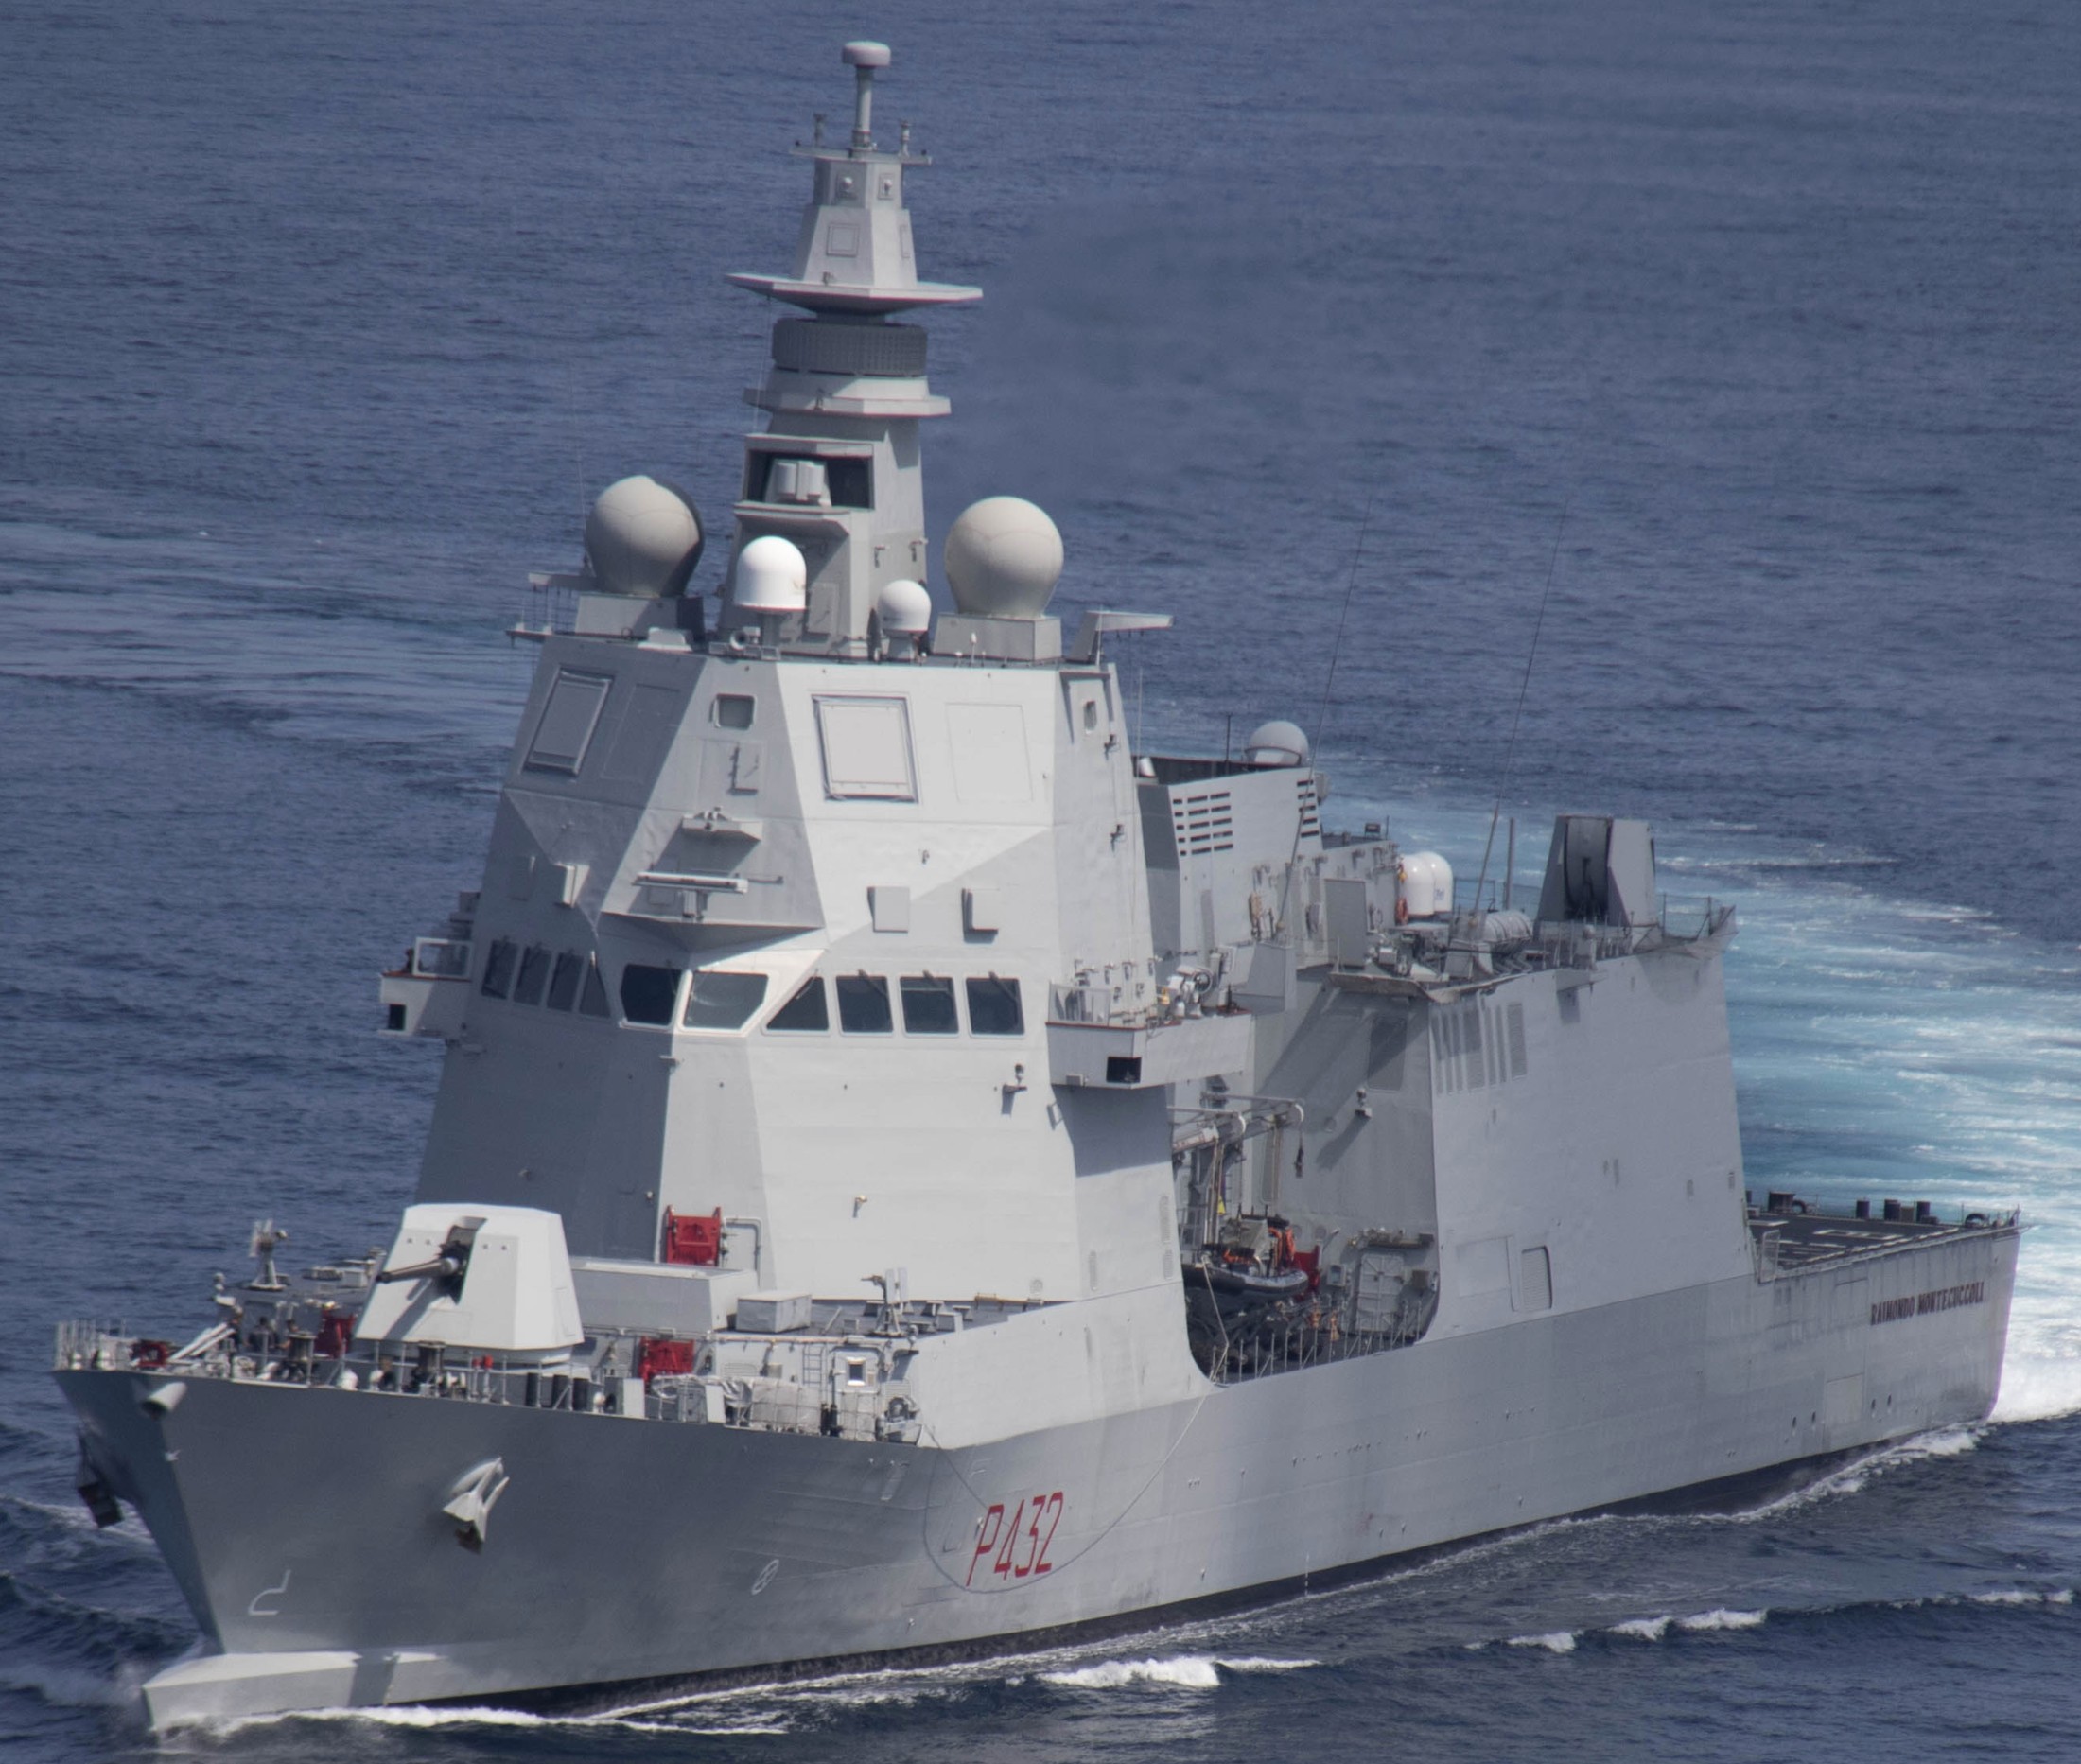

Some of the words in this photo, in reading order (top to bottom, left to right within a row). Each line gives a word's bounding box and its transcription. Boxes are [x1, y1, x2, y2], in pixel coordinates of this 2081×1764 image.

[1871, 1296, 1915, 1326] RAIMONDO
[1917, 1282, 1985, 1316] MONTECUCCOLI
[966, 1491, 1064, 1586] P432
